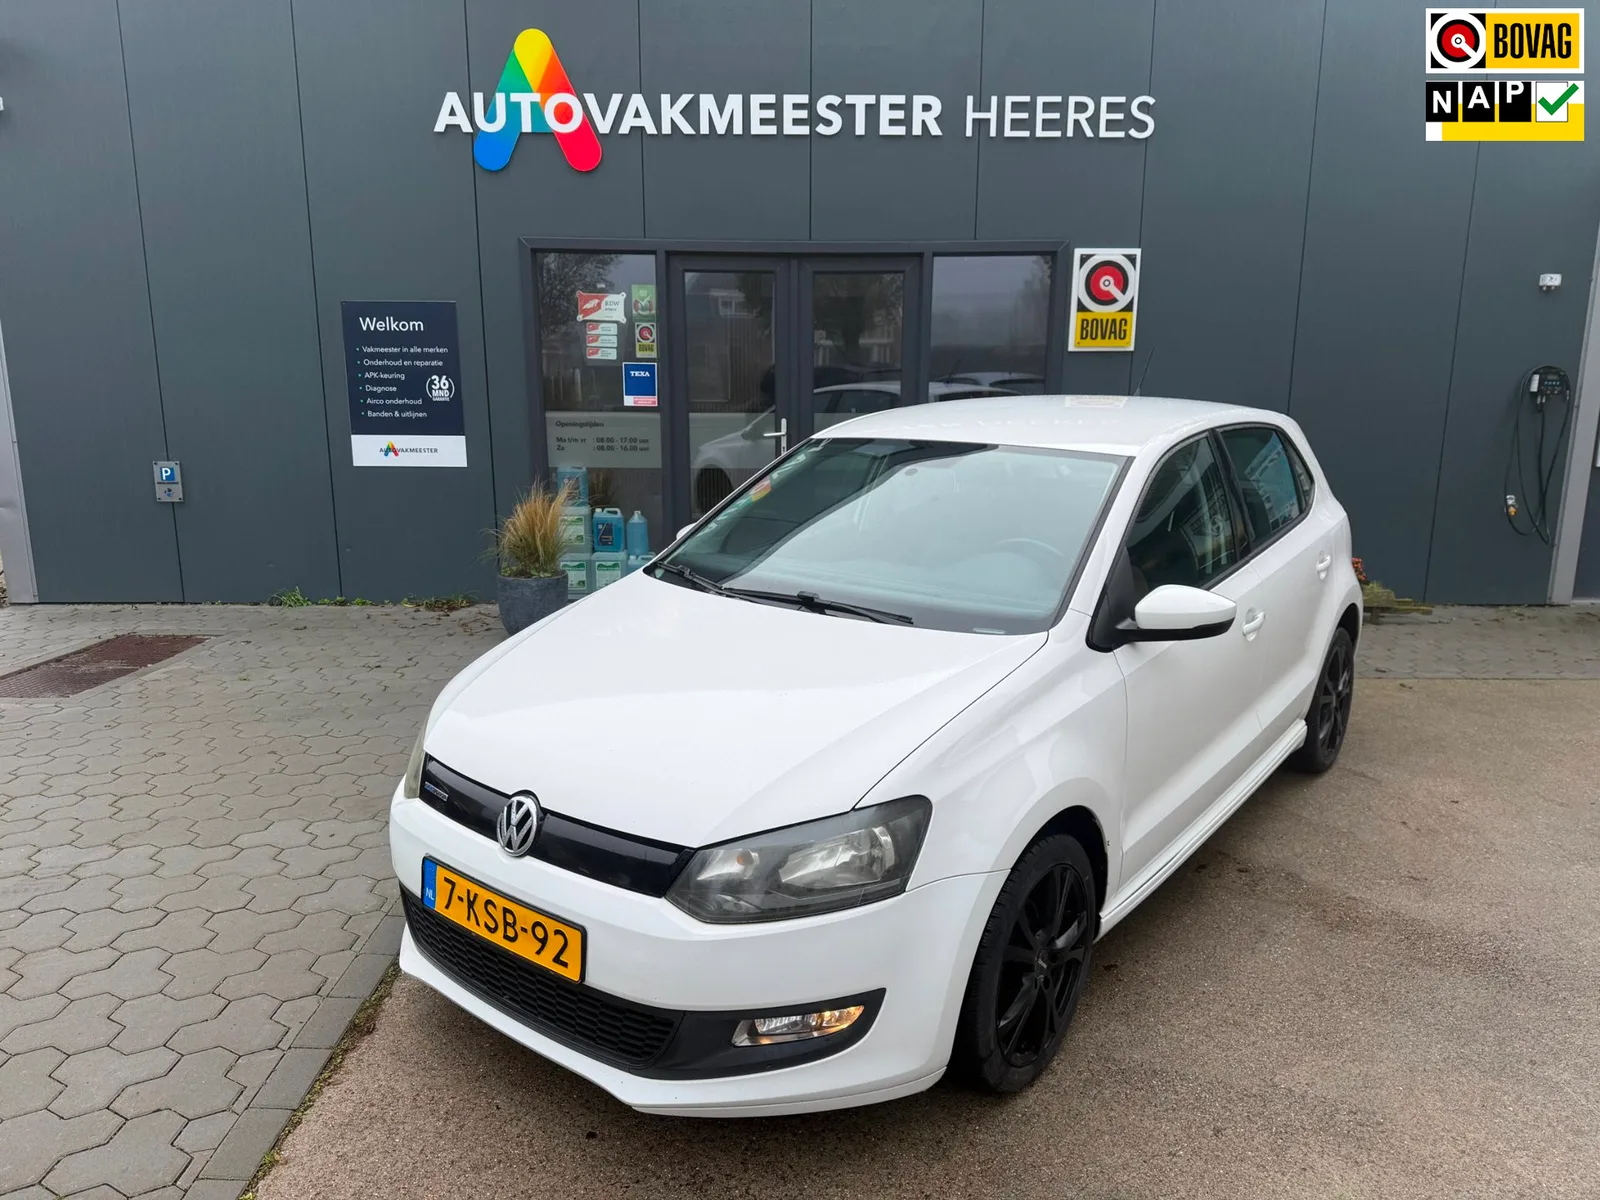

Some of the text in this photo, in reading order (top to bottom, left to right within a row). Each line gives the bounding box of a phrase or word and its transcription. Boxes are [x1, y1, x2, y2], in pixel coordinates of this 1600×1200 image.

[433, 91, 1156, 139] AUTOVAKMEESTER HEERES
[359, 316, 424, 331] Welkom
[1080, 318, 1128, 341] BOVAG
[413, 359, 443, 368] reparatie
[364, 372, 405, 380] APK-keuring
[431, 375, 450, 390] 36
[365, 385, 397, 393] Diagnose
[367, 410, 394, 418] Banden
[401, 410, 428, 419] uitlijnen
[555, 420, 604, 428] Openingstijden
[161, 467, 171, 480] P
[425, 887, 435, 901] NL
[443, 876, 569, 969] 7-KSB-92
